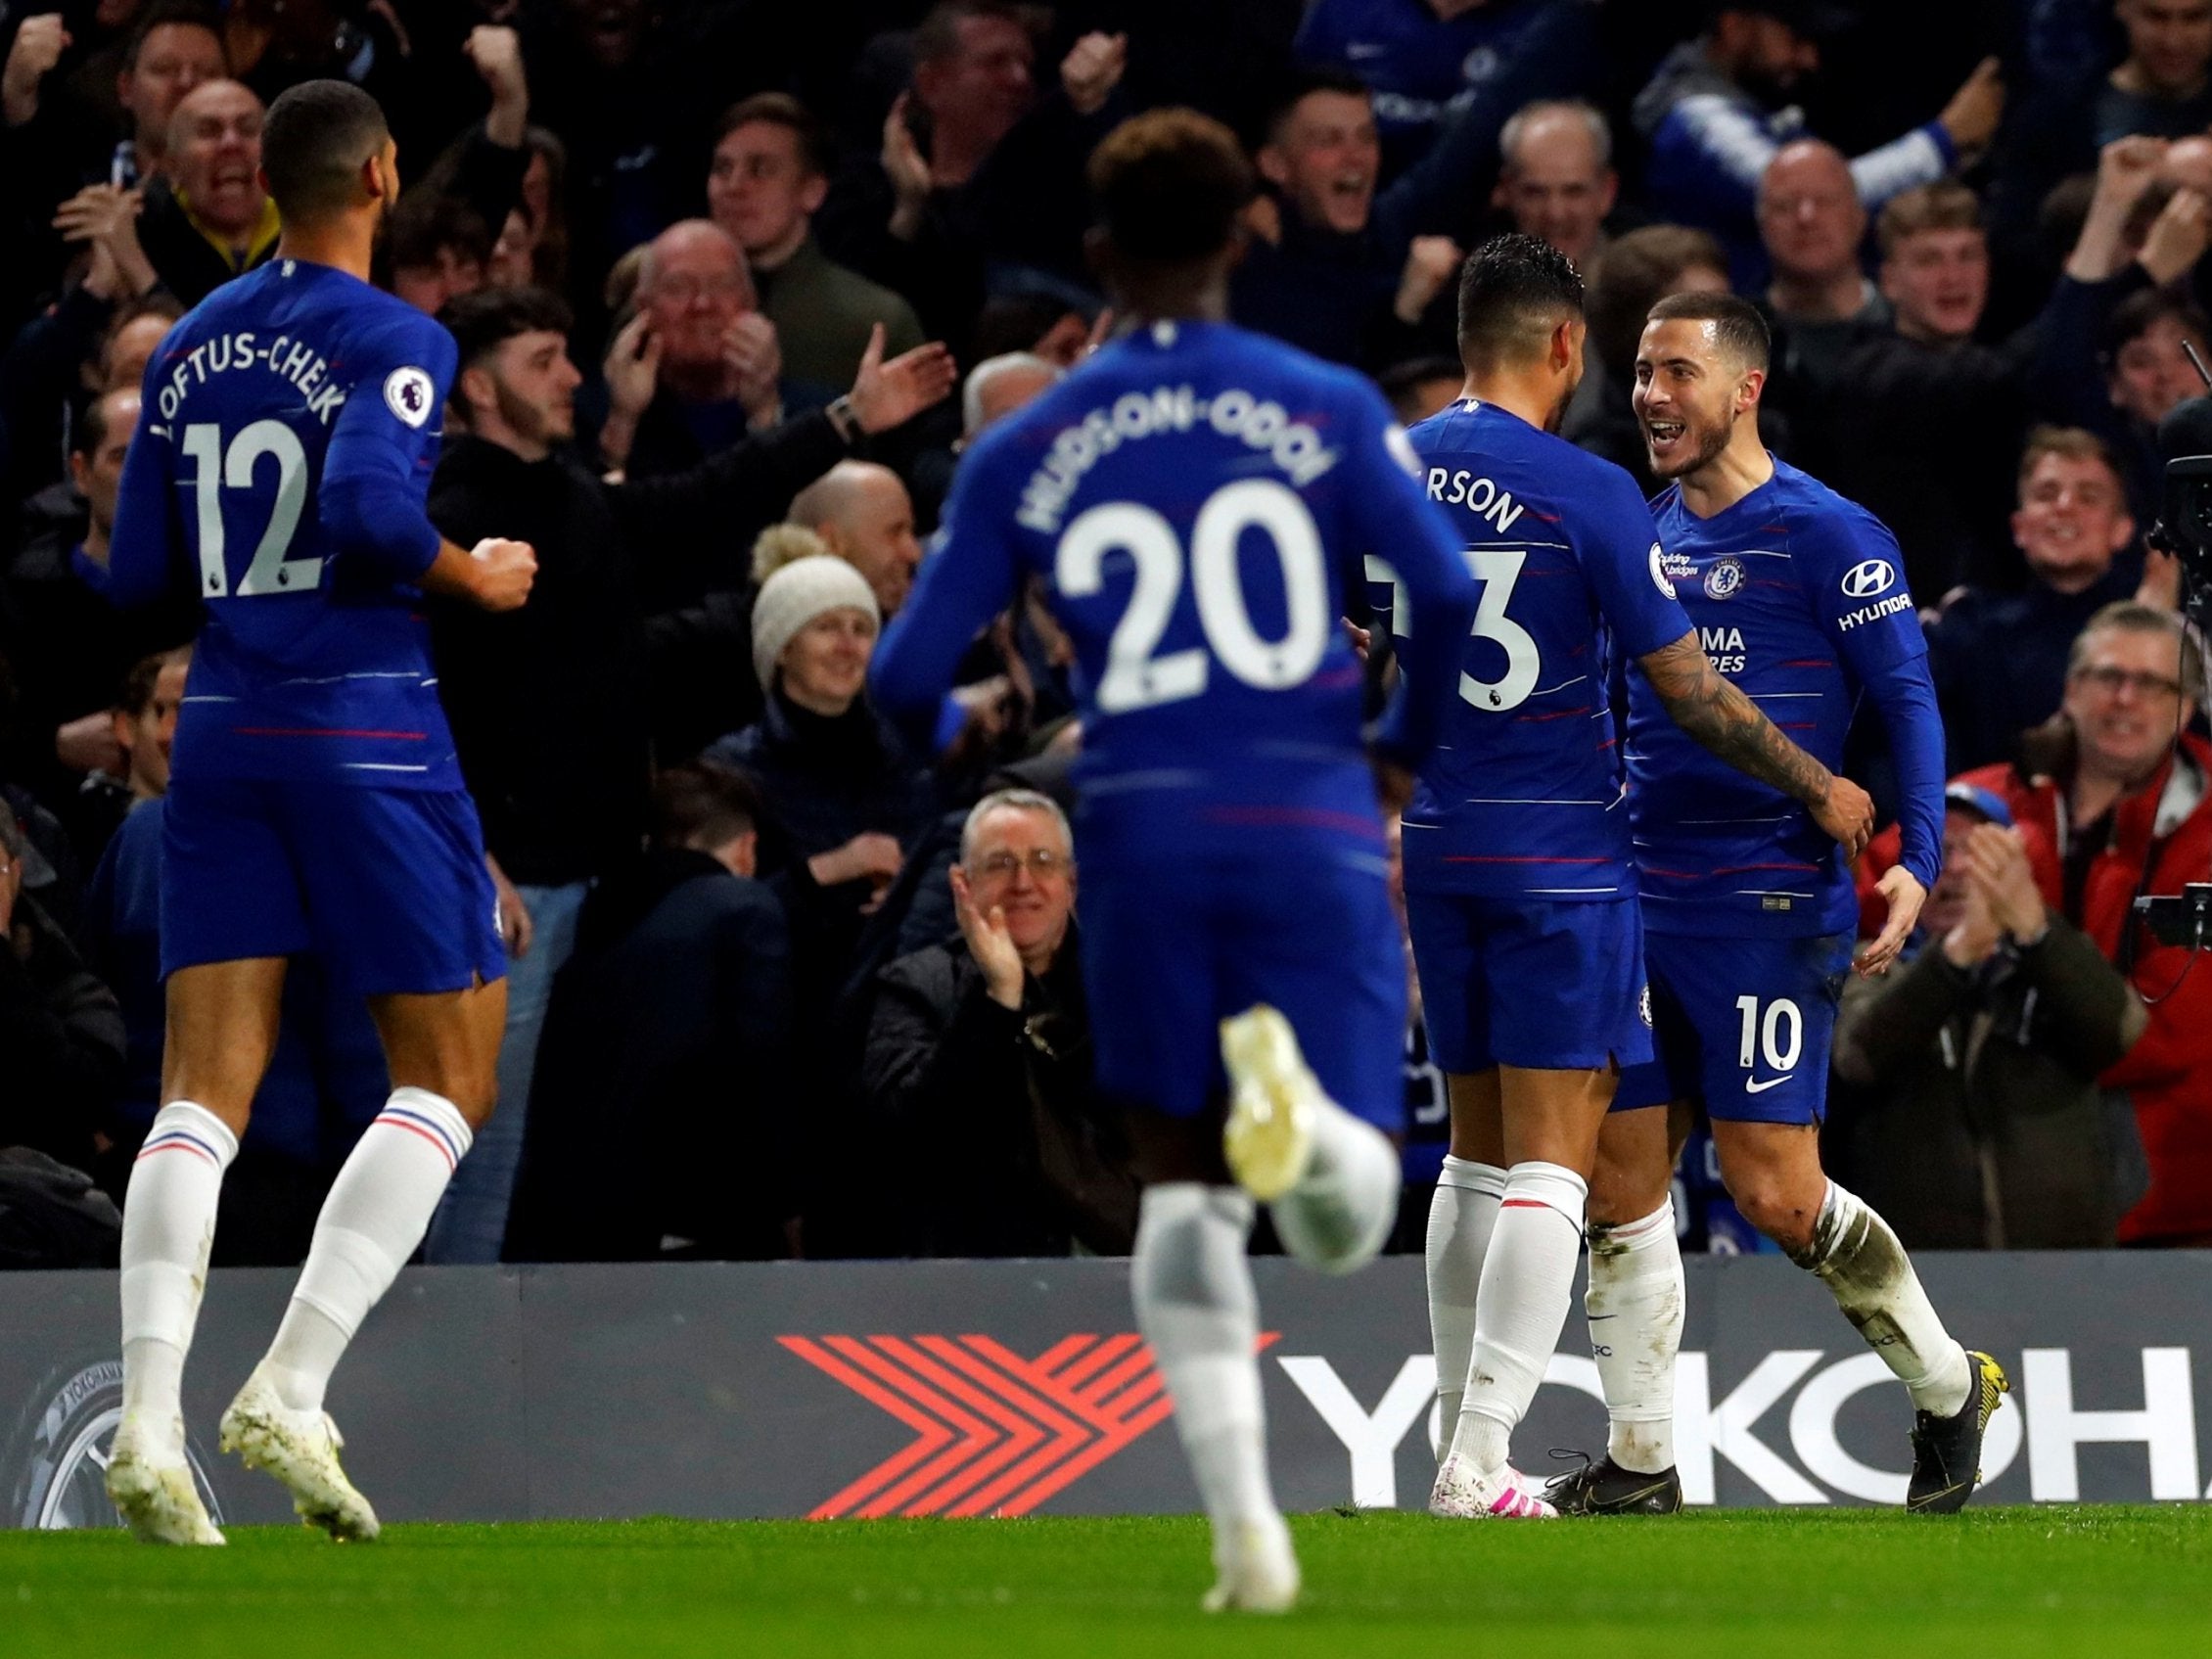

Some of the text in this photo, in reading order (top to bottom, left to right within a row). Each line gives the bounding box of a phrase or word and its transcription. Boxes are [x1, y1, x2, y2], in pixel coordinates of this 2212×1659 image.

[182, 419, 323, 598] 12
[1055, 478, 1330, 713] 20
[1735, 994, 1803, 1072] 10
